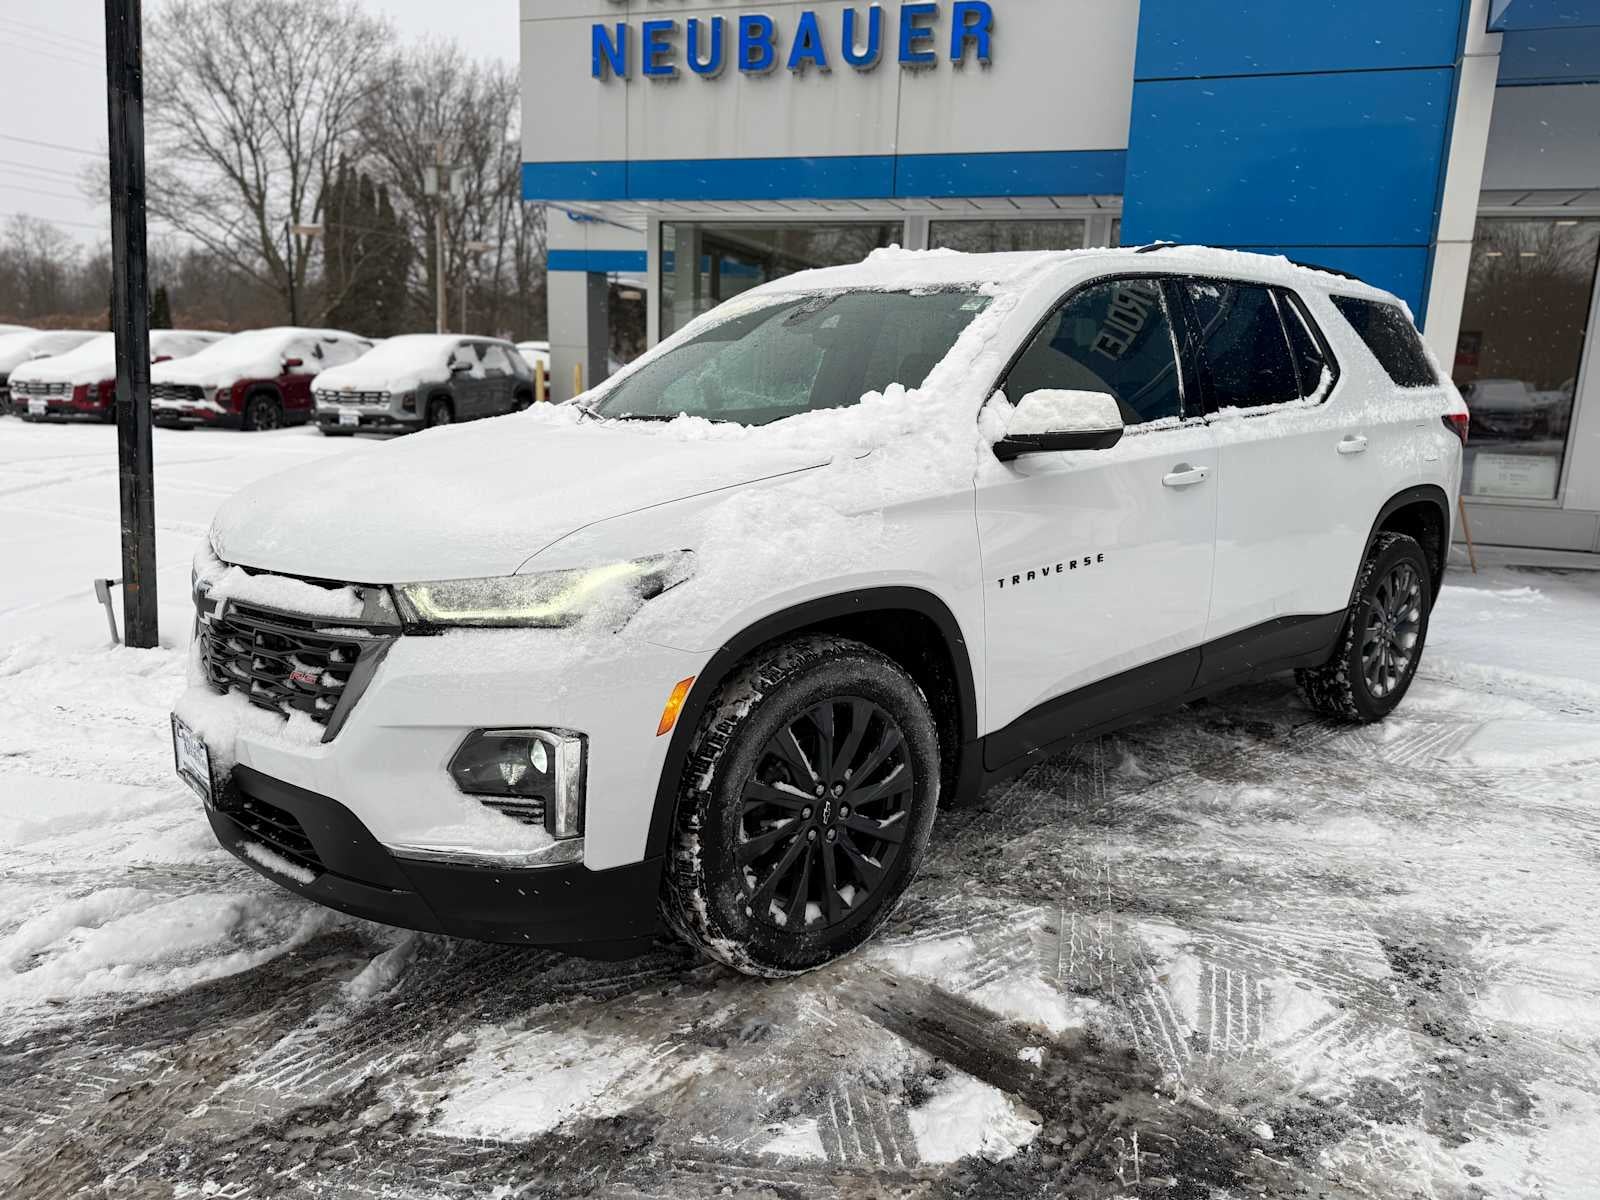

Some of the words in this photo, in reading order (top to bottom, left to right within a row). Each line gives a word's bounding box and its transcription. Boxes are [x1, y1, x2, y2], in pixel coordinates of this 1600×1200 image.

[591, 0, 995, 78] NEUBAUER
[997, 553, 1104, 588] TRAVERSE
[289, 671, 318, 685] RS
